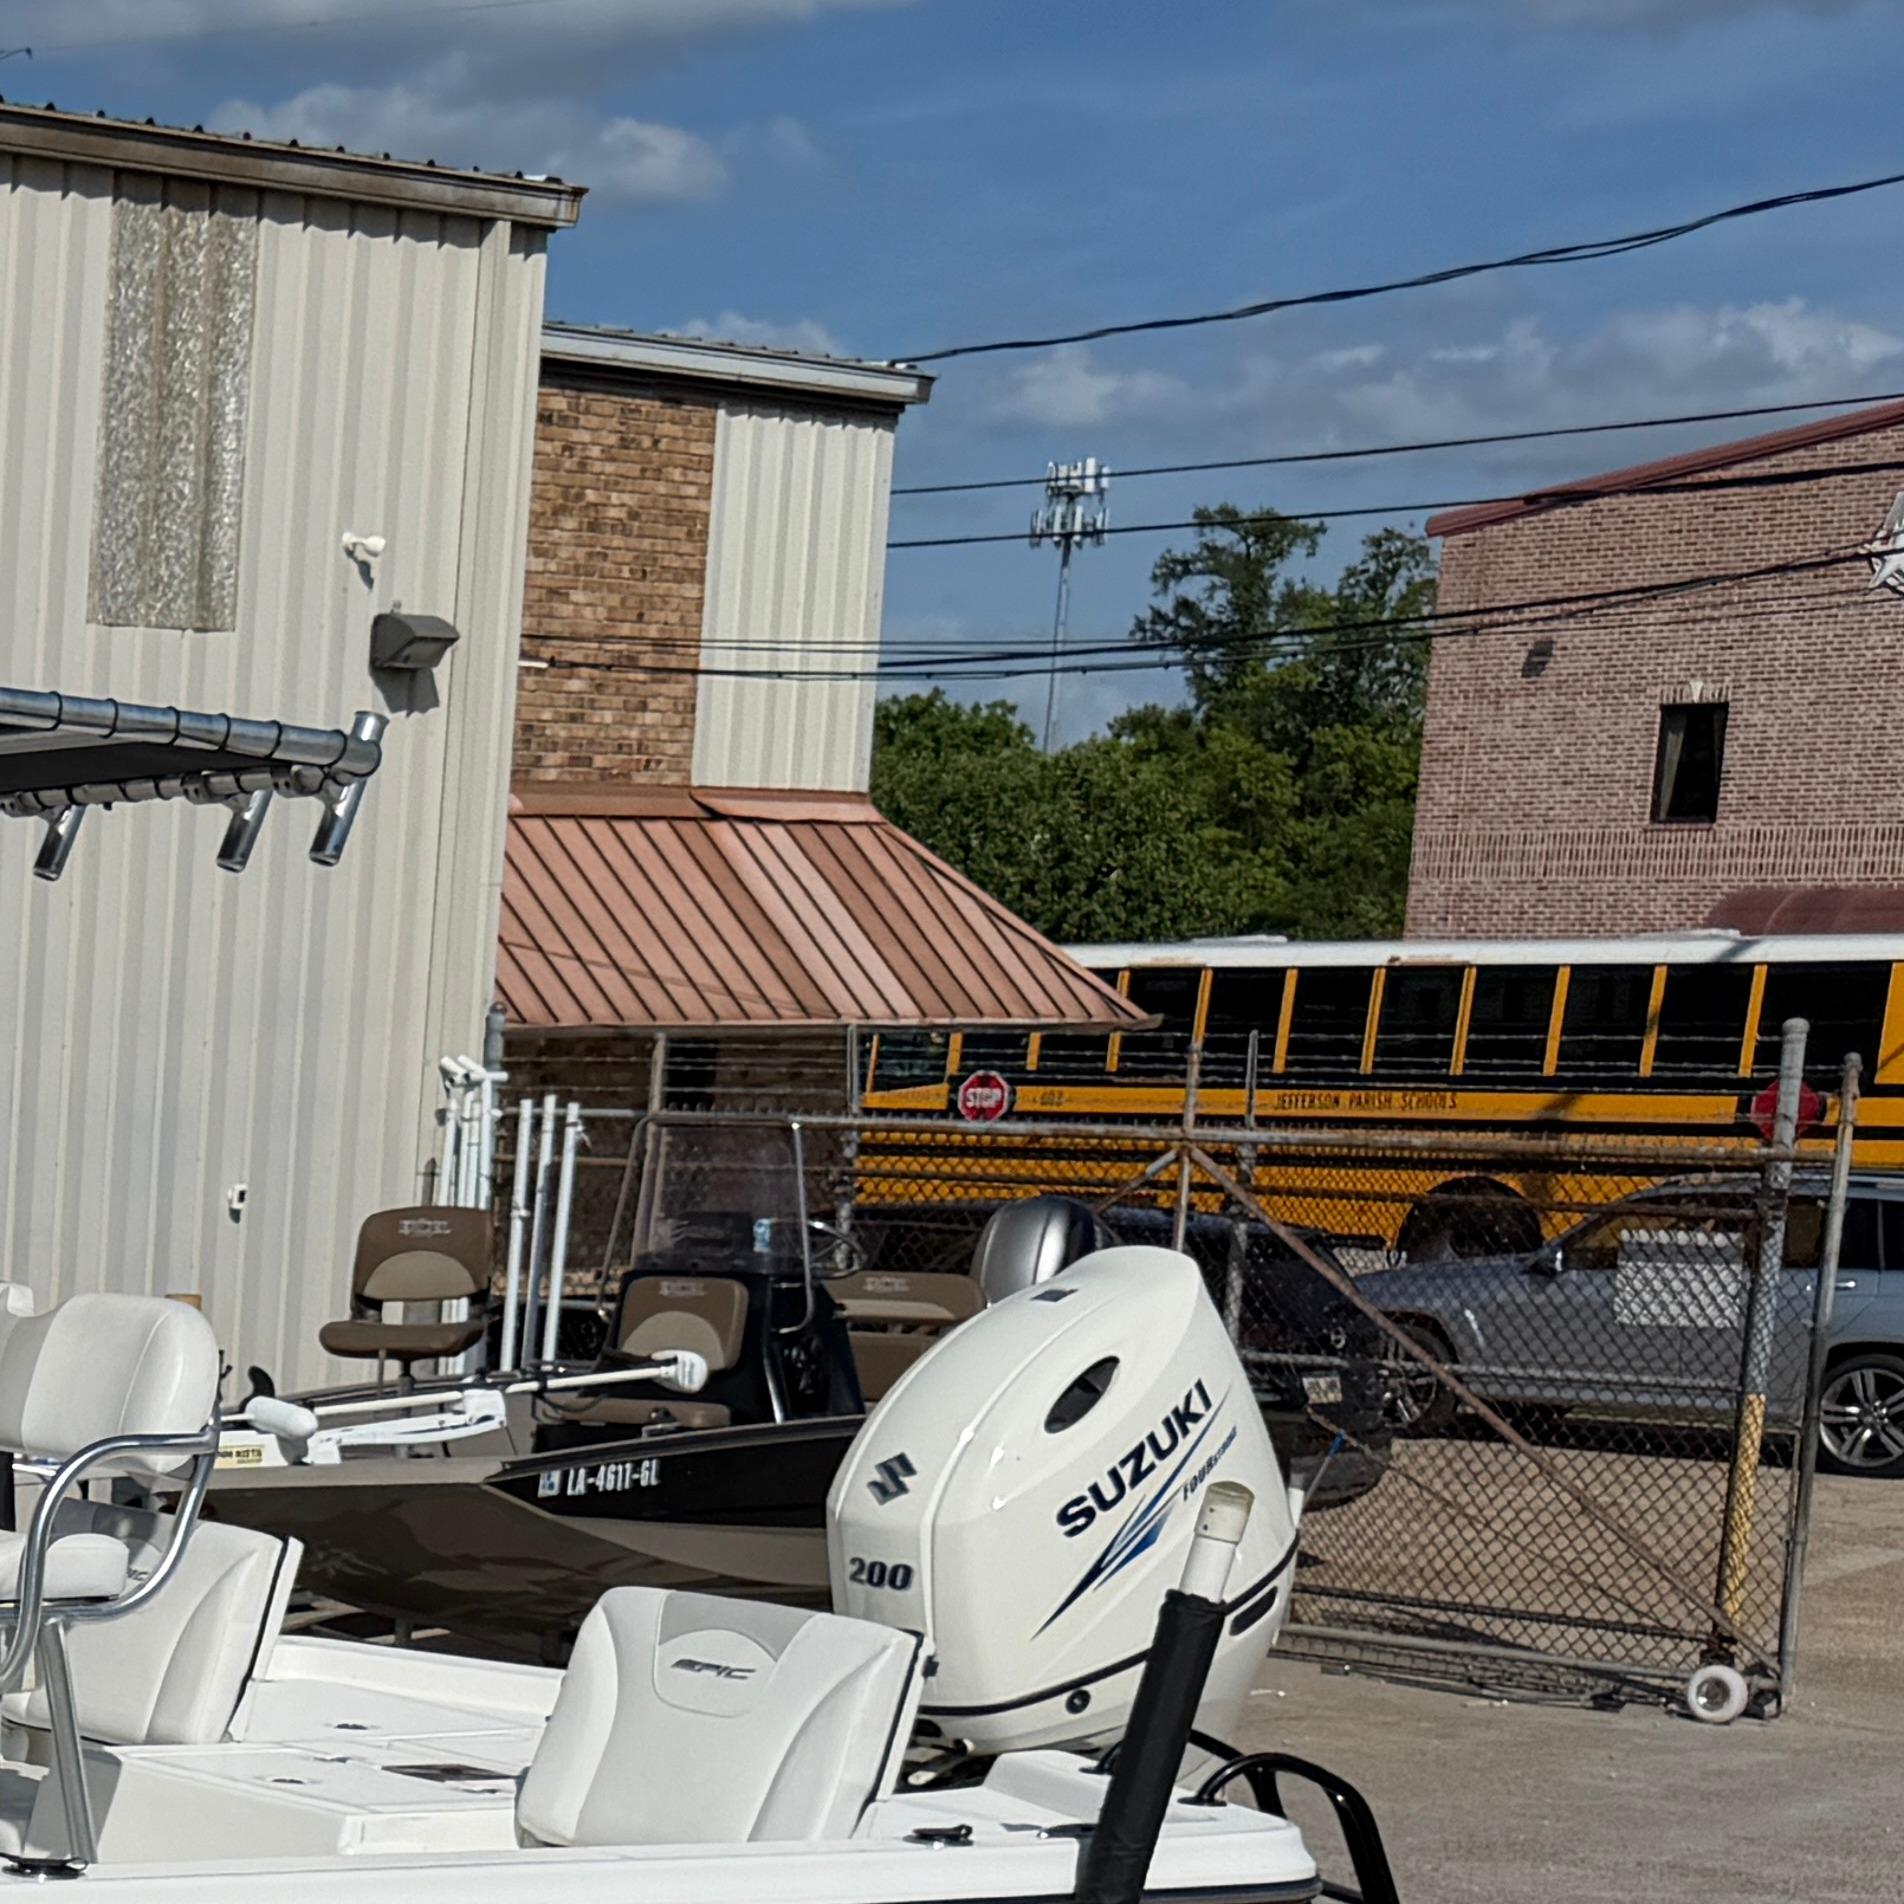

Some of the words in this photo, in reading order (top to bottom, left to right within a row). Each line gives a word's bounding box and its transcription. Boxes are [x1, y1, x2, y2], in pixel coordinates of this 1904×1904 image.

[1056, 1378, 1212, 1537] SUZUKI
[849, 1557, 914, 1591] 200
[670, 1659, 756, 1680] EPIC
